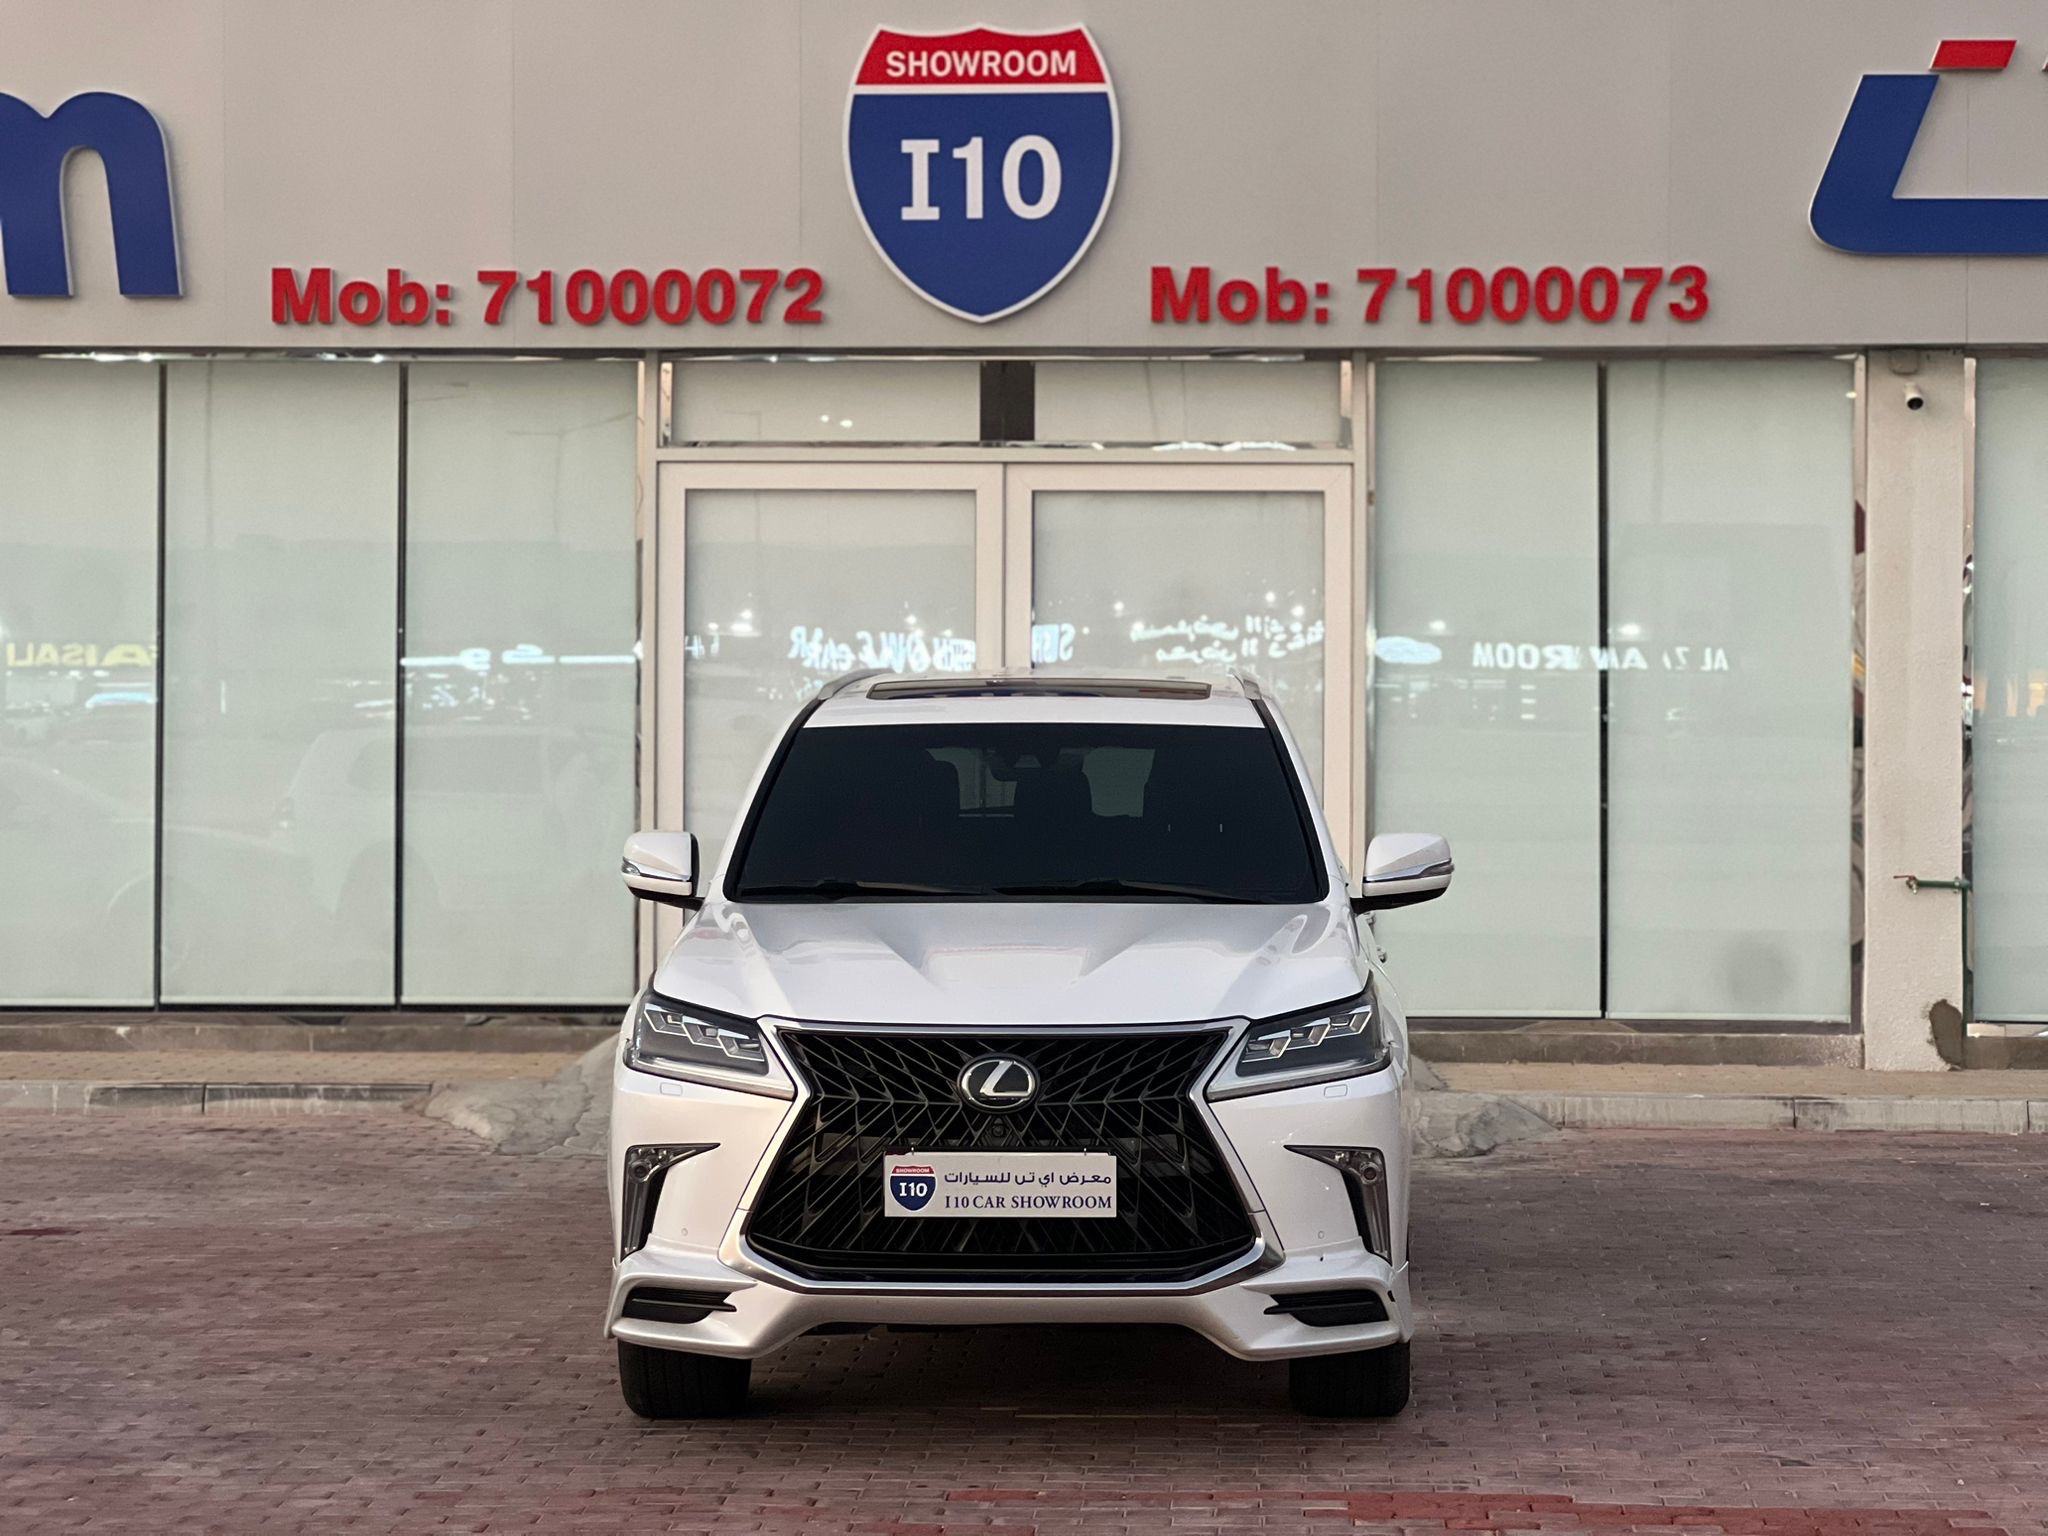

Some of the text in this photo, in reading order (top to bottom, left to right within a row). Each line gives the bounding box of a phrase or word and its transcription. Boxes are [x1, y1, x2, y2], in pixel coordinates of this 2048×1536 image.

[886, 49, 1077, 78] SHOWROOM
[900, 134, 1063, 221] I10
[271, 267, 825, 326] Mob: 71000072
[1150, 265, 1711, 324] Mob: 71000073
[899, 1181, 929, 1198] I10
[944, 1171, 1011, 1186] للسيارات
[1059, 1171, 1112, 1186] معرض
[972, 1195, 1007, 1209] CAR
[1010, 1195, 1112, 1209] SHOWROOM
